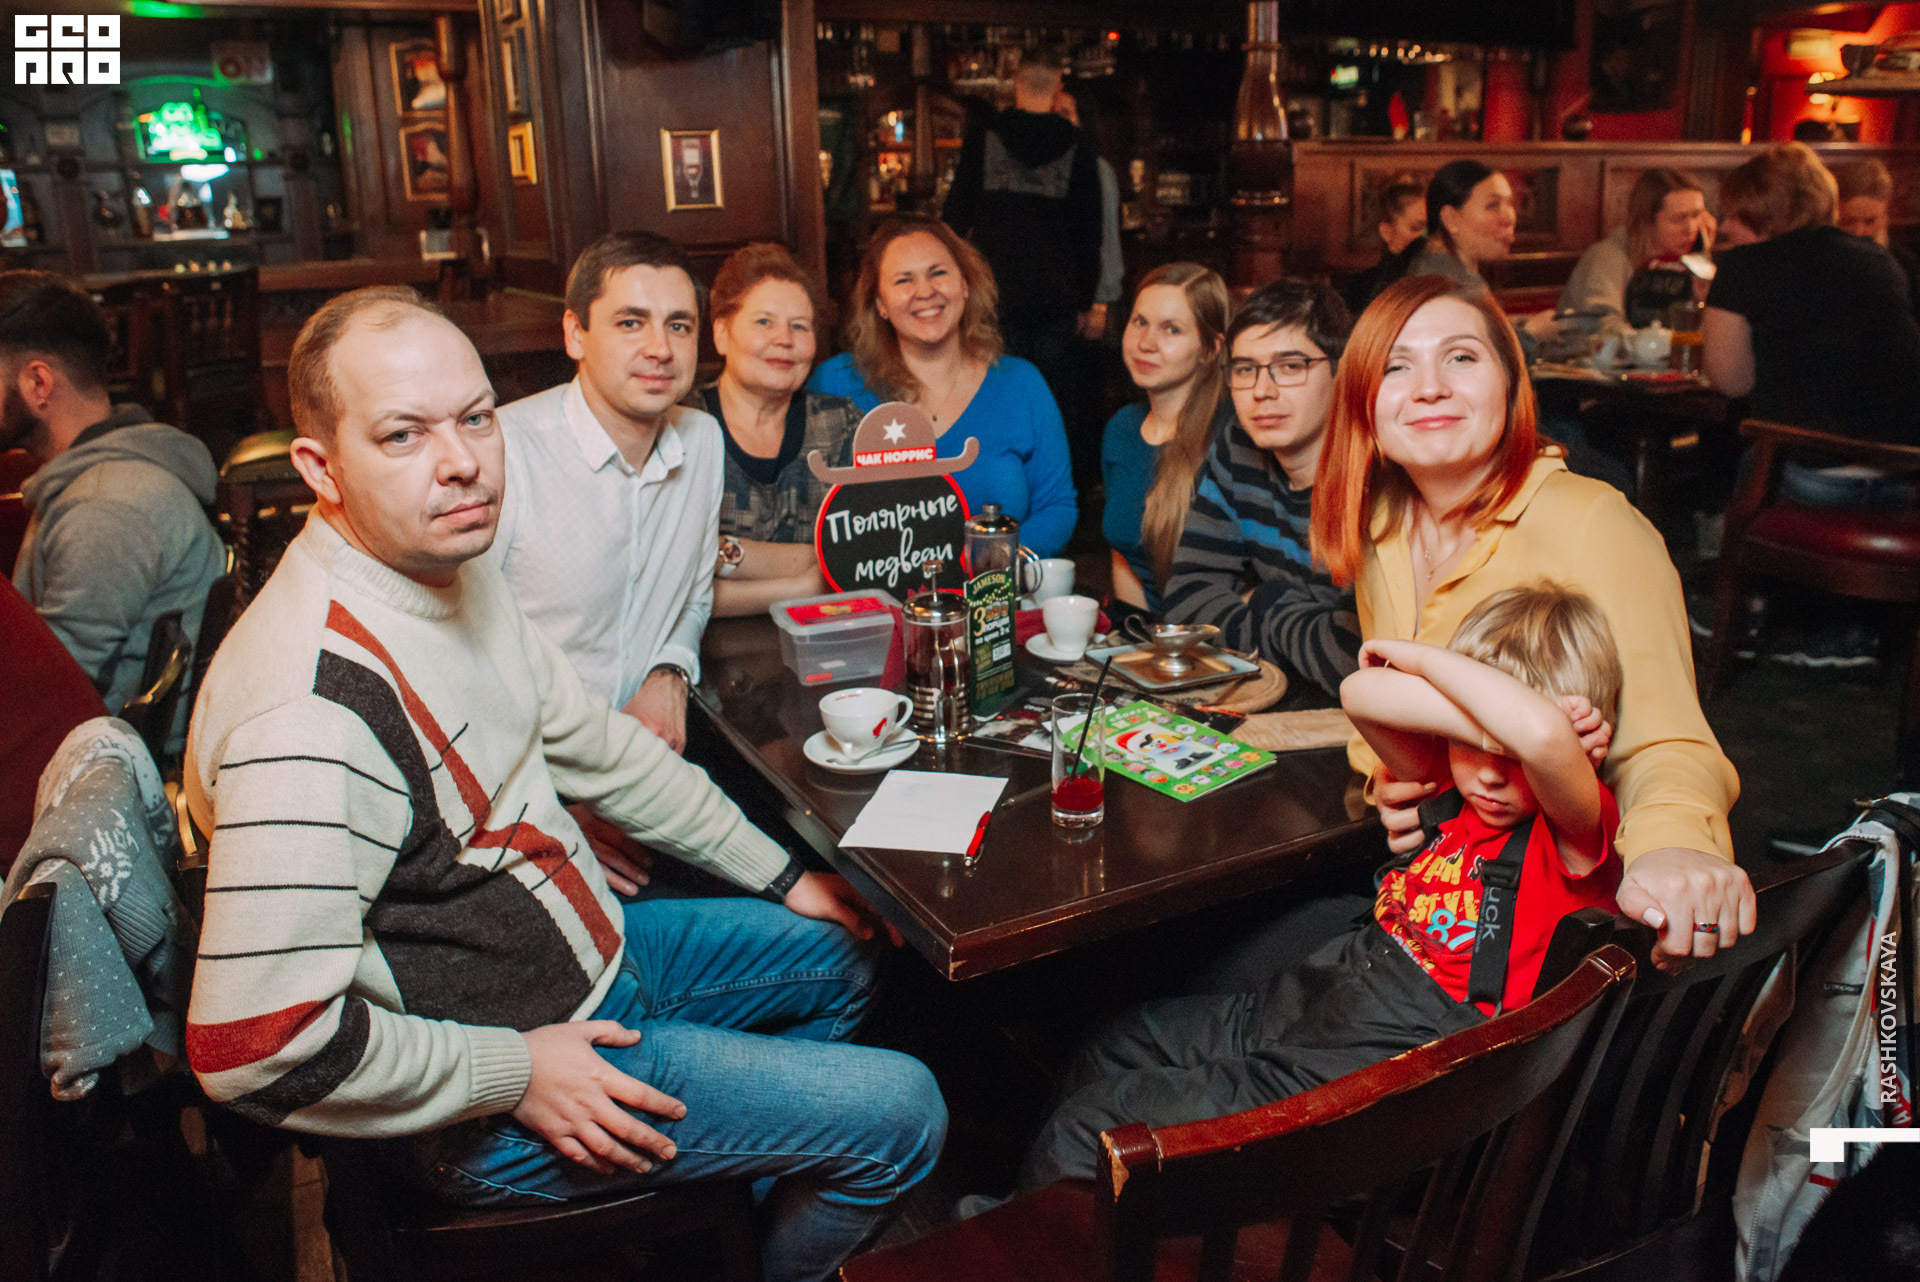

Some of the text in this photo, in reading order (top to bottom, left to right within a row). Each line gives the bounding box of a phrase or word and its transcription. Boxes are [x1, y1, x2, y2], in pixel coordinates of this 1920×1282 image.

[856, 448, 934, 466] ЧАК НОРРИС
[825, 494, 958, 543] Полярные
[855, 527, 953, 588] медведи
[973, 574, 1006, 595] JAMESON
[973, 606, 987, 637] 3
[1408, 890, 1480, 924] STYL
